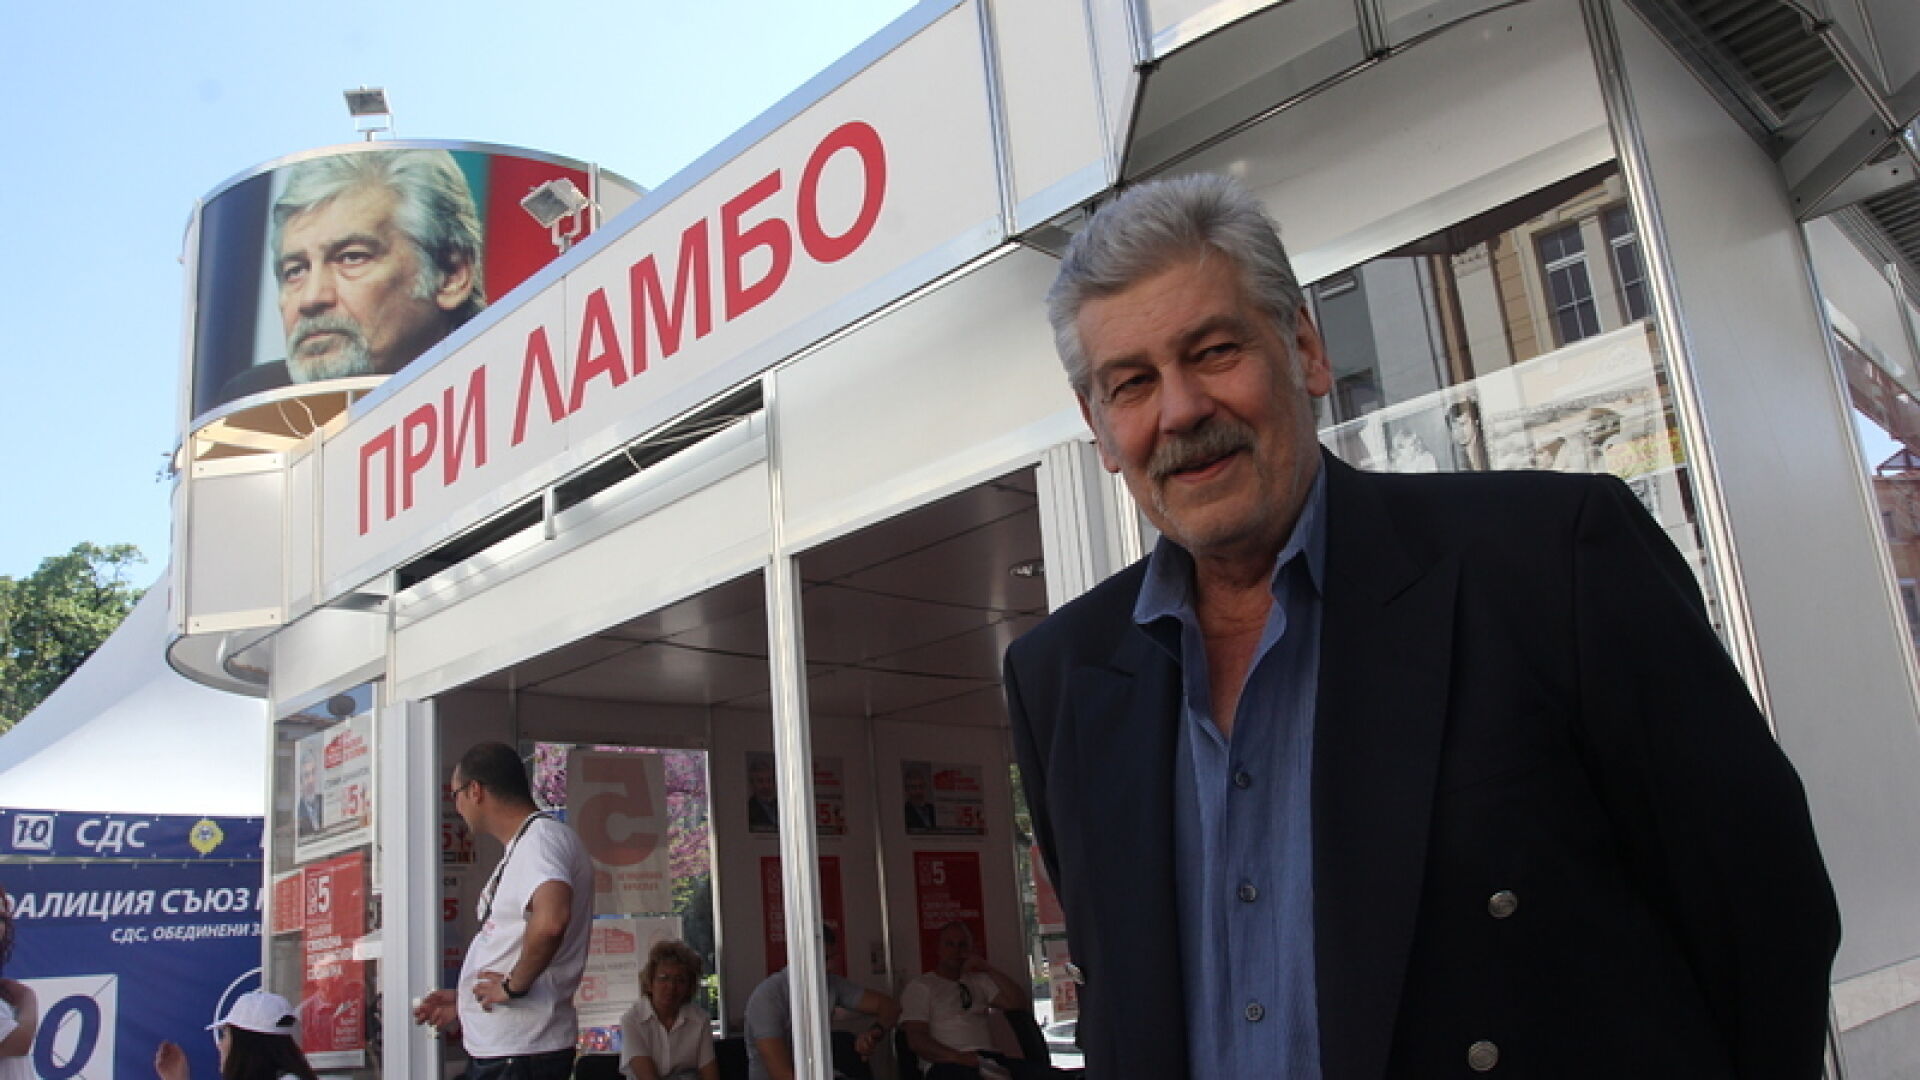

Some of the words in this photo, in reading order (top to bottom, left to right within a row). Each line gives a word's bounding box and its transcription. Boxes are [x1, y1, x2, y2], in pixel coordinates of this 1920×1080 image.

[359, 363, 489, 537] ПРИ
[510, 120, 888, 448] ЛАМБО
[18, 819, 49, 843] 10
[76, 819, 150, 853] СДС
[161, 887, 250, 914] СЪЮЗ
[153, 922, 248, 942] ОБЕДИНЕНИ
[33, 993, 101, 1080] 0
